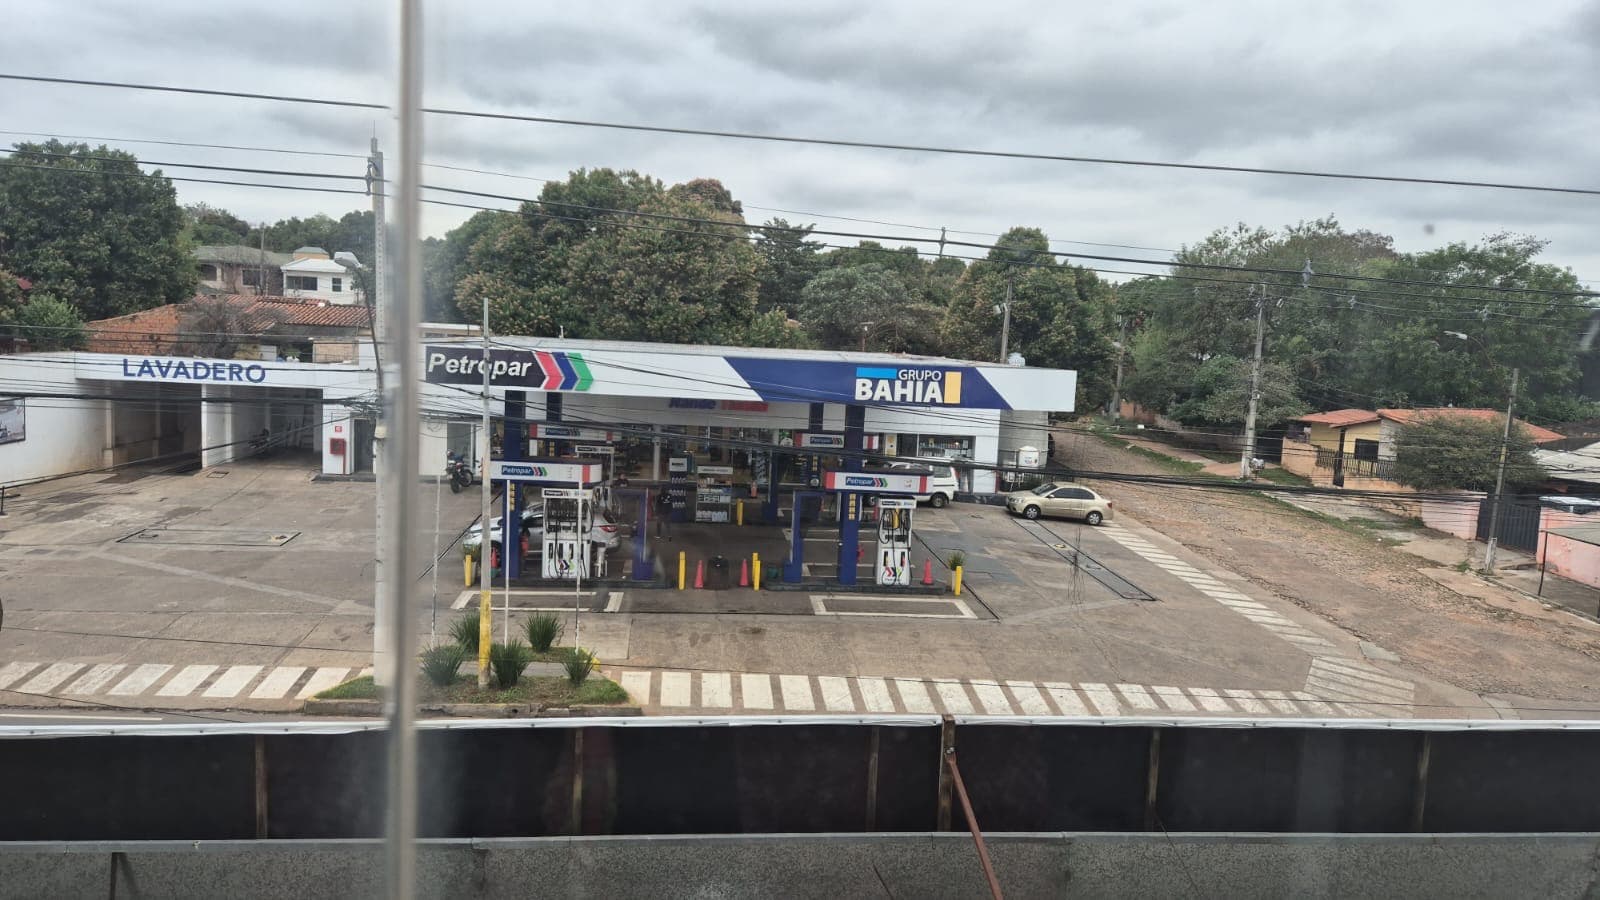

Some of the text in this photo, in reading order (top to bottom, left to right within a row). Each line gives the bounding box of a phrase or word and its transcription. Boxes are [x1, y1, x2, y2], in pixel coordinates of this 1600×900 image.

[122, 358, 266, 384] LAVADERO
[428, 352, 533, 380] Petropar
[898, 369, 942, 381] GRUPO
[855, 378, 943, 404] BAHIA
[502, 465, 532, 476] Petropar
